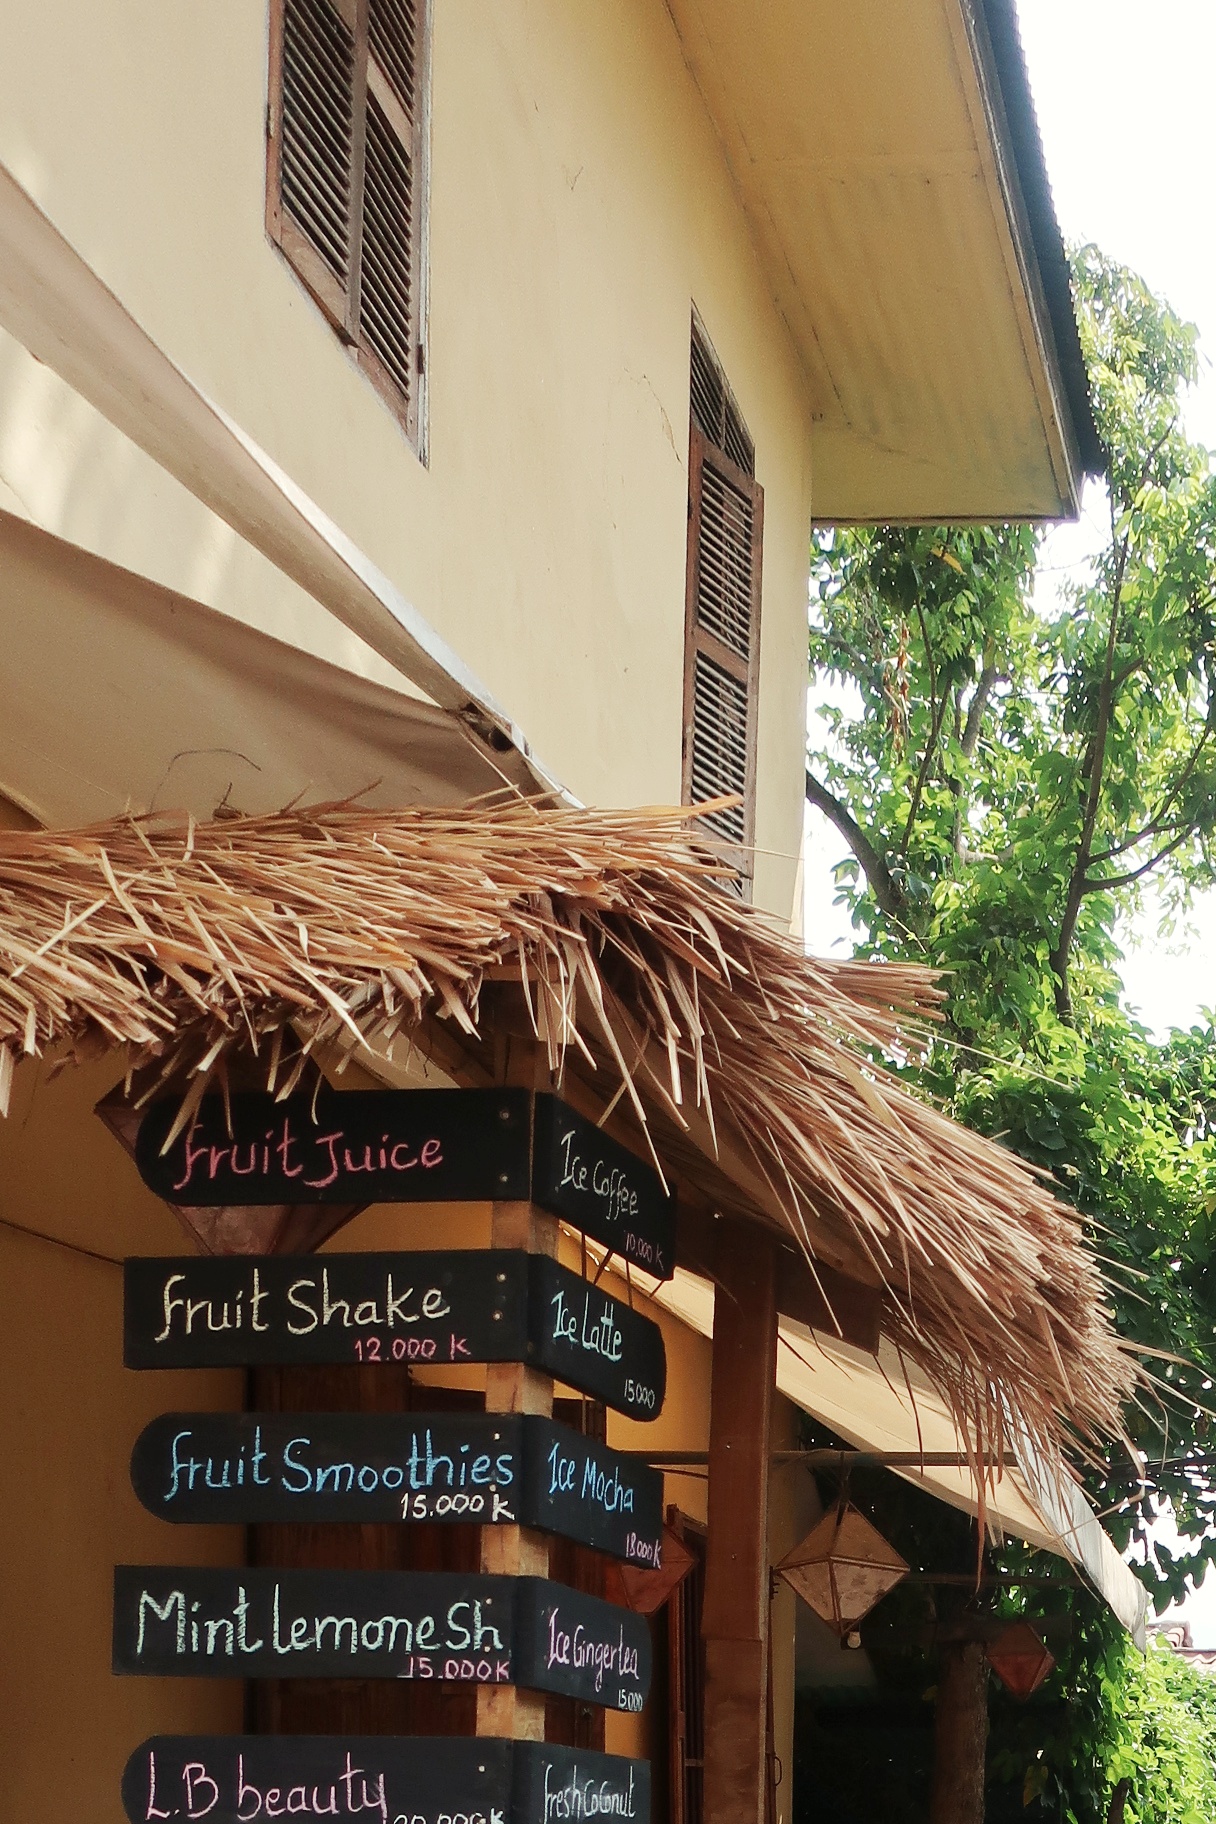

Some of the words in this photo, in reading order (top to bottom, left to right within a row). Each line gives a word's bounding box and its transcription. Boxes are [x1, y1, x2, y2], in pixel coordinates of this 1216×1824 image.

[302, 1131, 443, 1187] Juice
[560, 1130, 589, 1190] Ice
[593, 1160, 639, 1220] Coffee
[287, 1268, 450, 1335] Shake
[550, 1290, 579, 1342] Ice
[581, 1291, 622, 1362] Latte
[281, 1428, 514, 1493] Smoothies
[547, 1442, 576, 1493] Ice
[581, 1457, 634, 1513] Mocha
[136, 1587, 263, 1656] Mint
[547, 1607, 571, 1670] Ice
